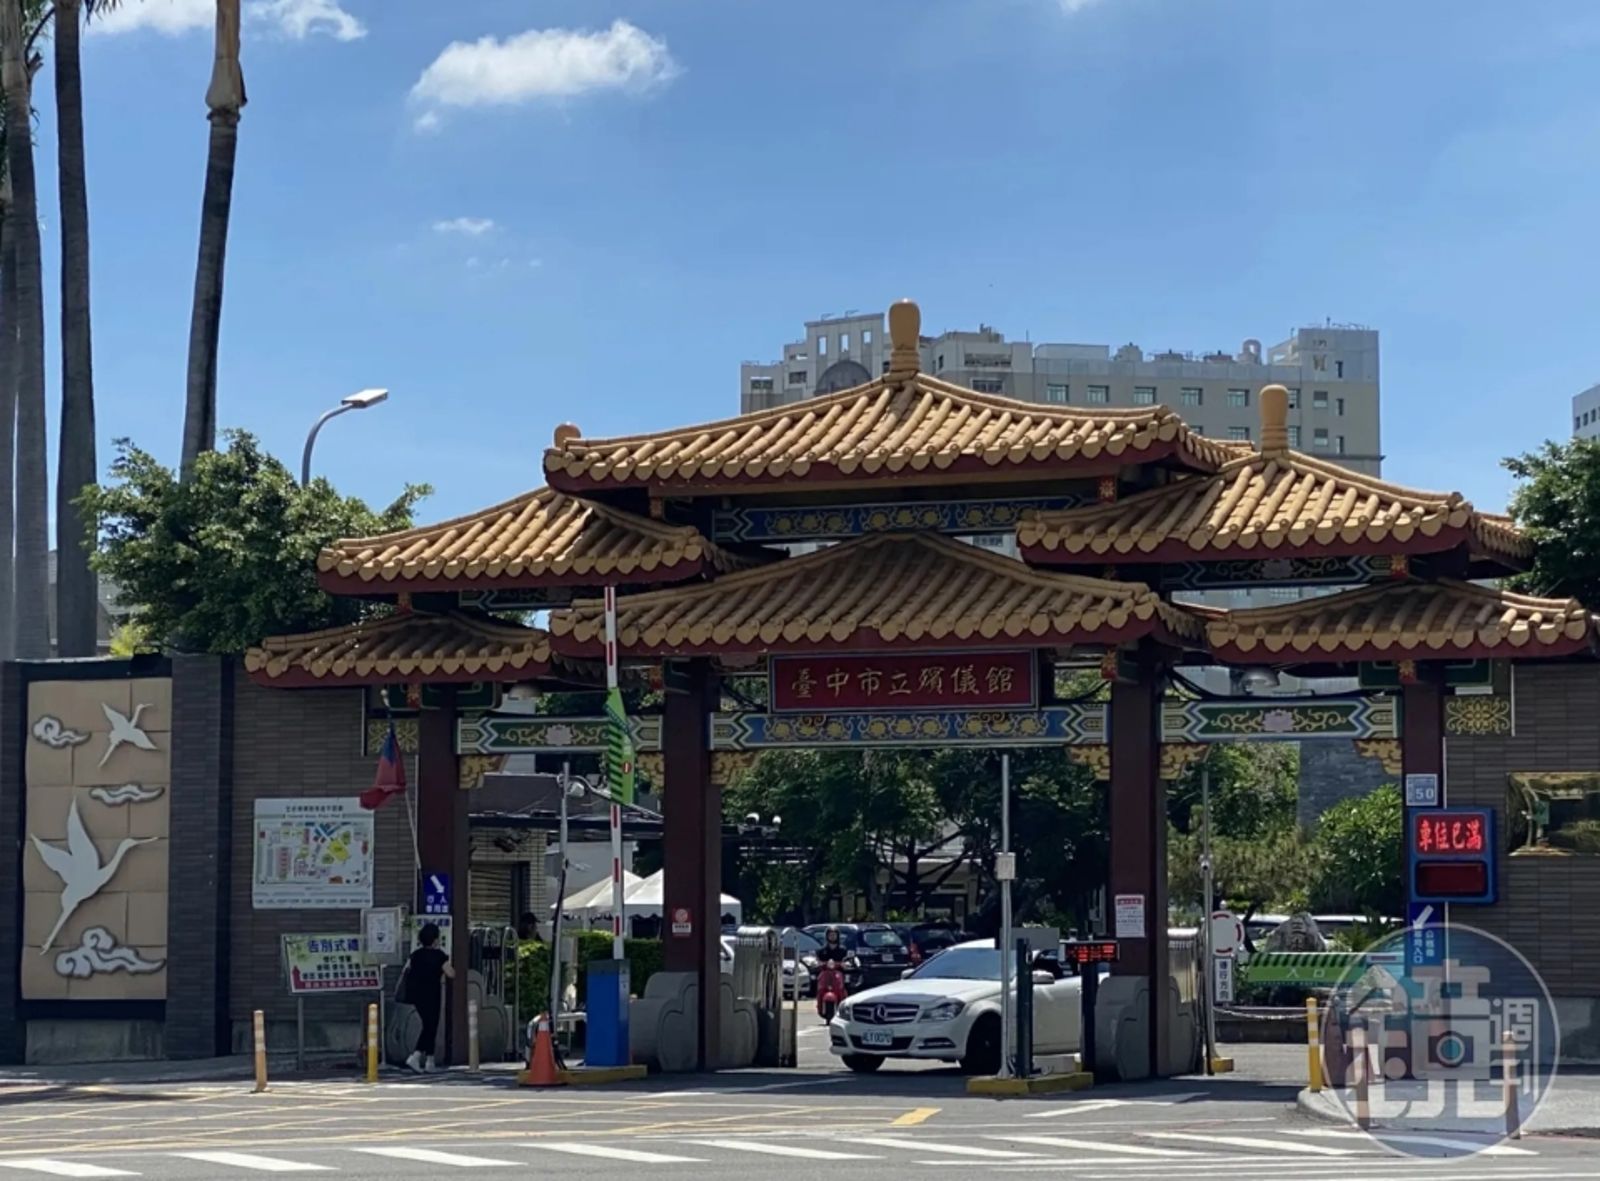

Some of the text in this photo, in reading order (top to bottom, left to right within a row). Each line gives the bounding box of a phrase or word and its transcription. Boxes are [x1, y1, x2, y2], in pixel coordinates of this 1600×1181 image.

[791, 664, 1015, 698] 臺中市立殯儀館
[1415, 787, 1435, 800] 50
[1287, 967, 1325, 978] 入口
